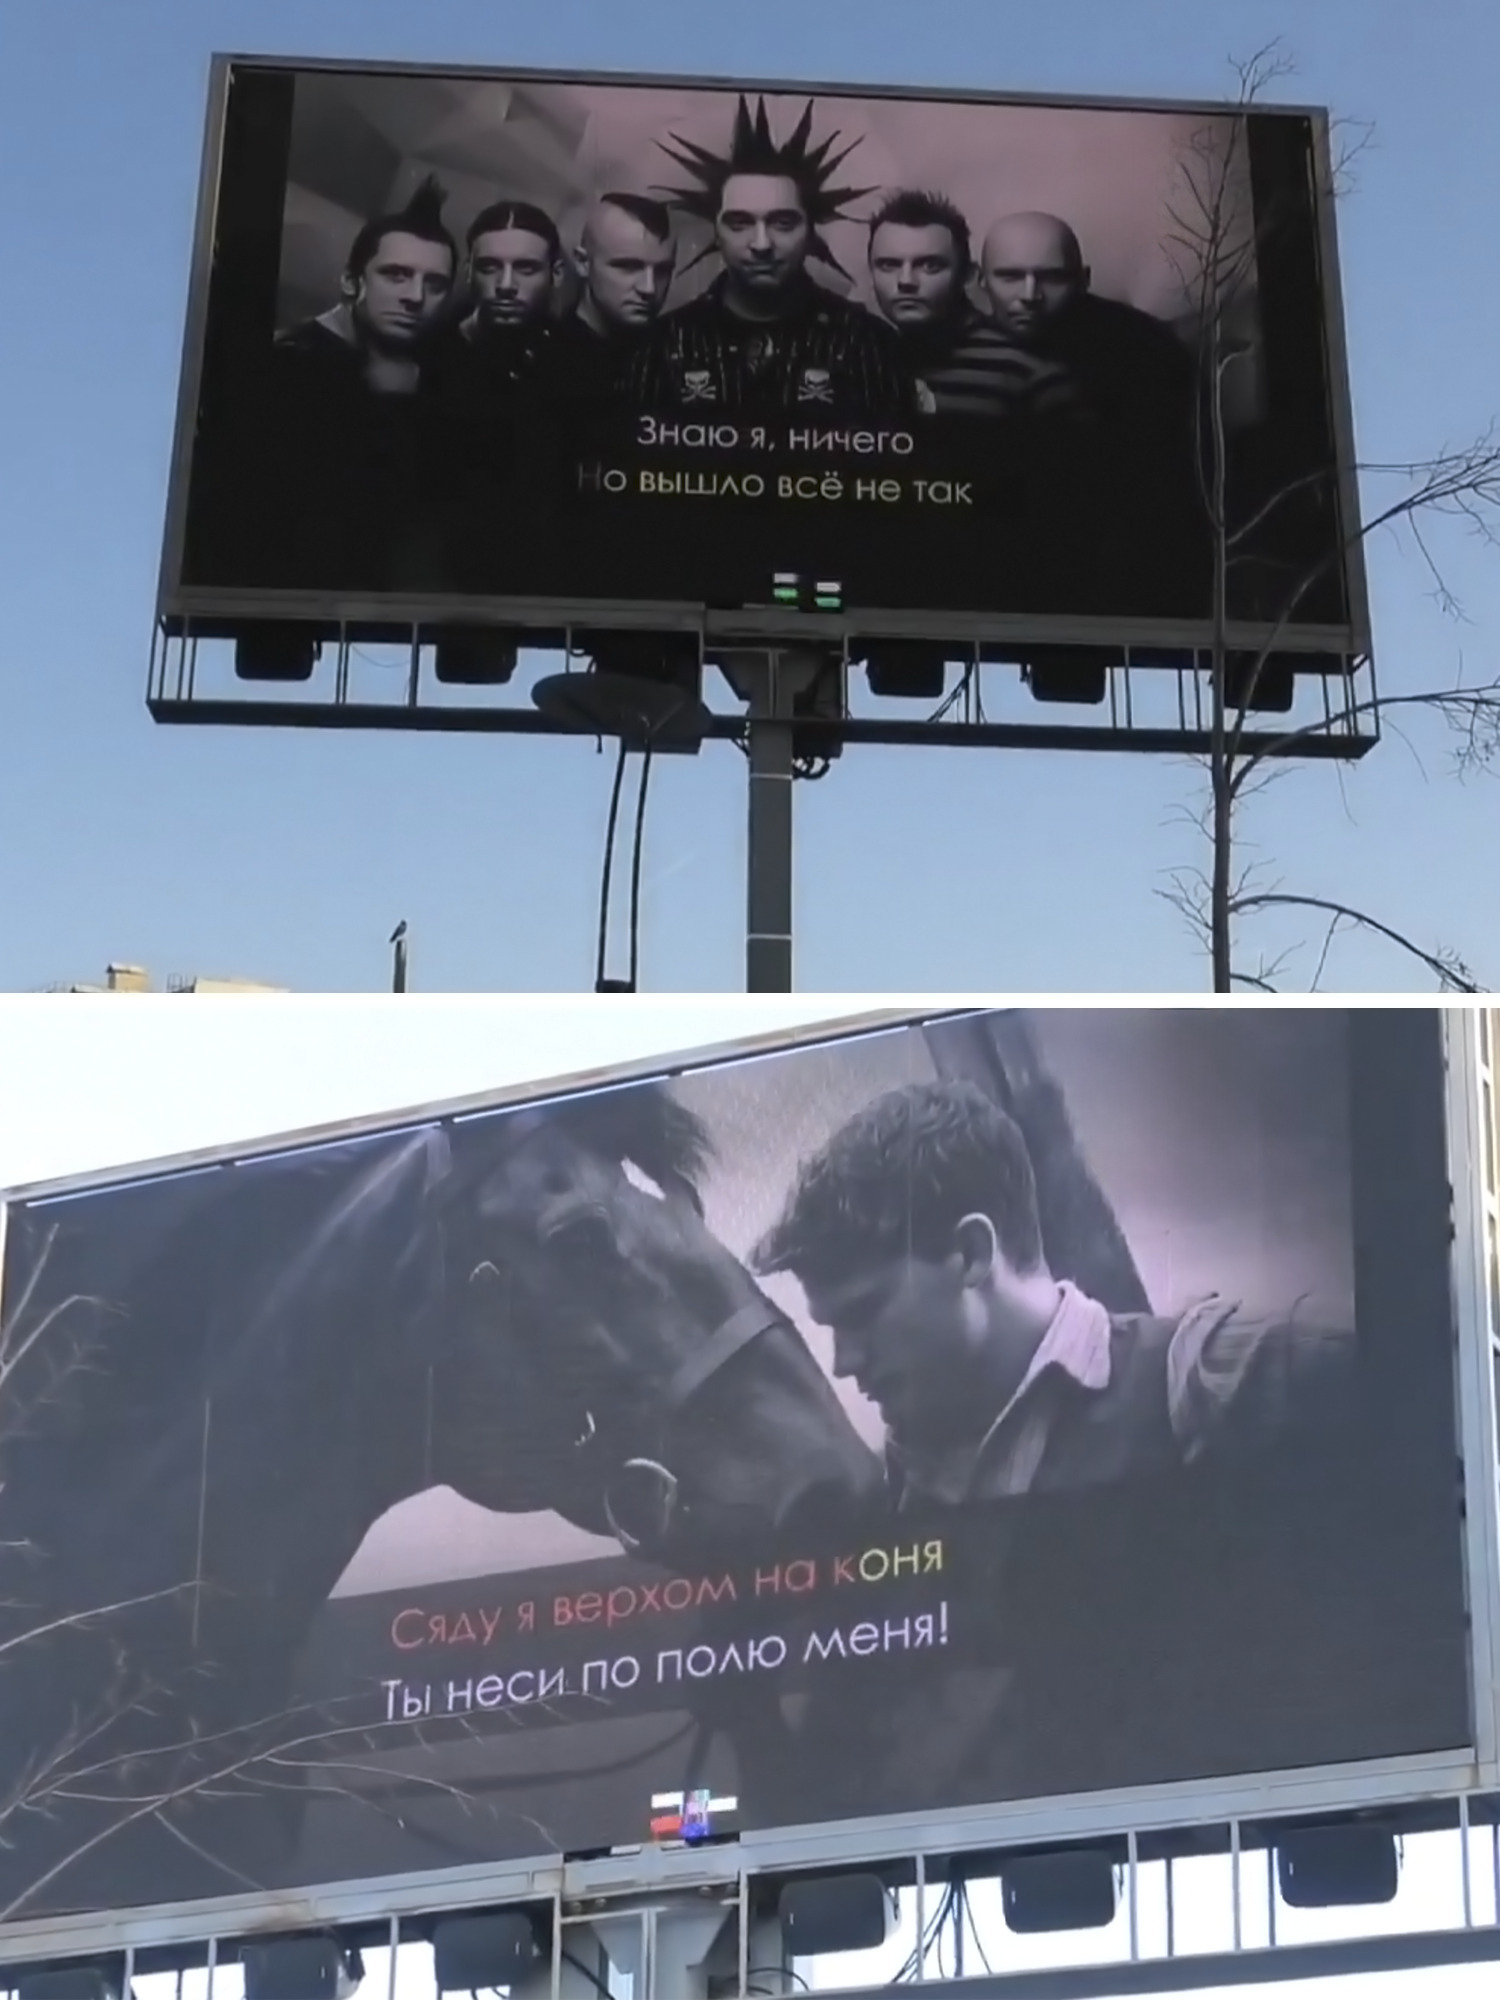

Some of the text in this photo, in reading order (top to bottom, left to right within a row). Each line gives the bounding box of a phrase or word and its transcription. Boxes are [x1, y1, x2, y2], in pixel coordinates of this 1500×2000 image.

[637, 415, 915, 455] Знаю я, ничего
[577, 463, 974, 505] Но вышло всё не так
[391, 1539, 943, 1650] Сяду я верхом на коня
[381, 1601, 950, 1721] Ты неси по полю меня!
